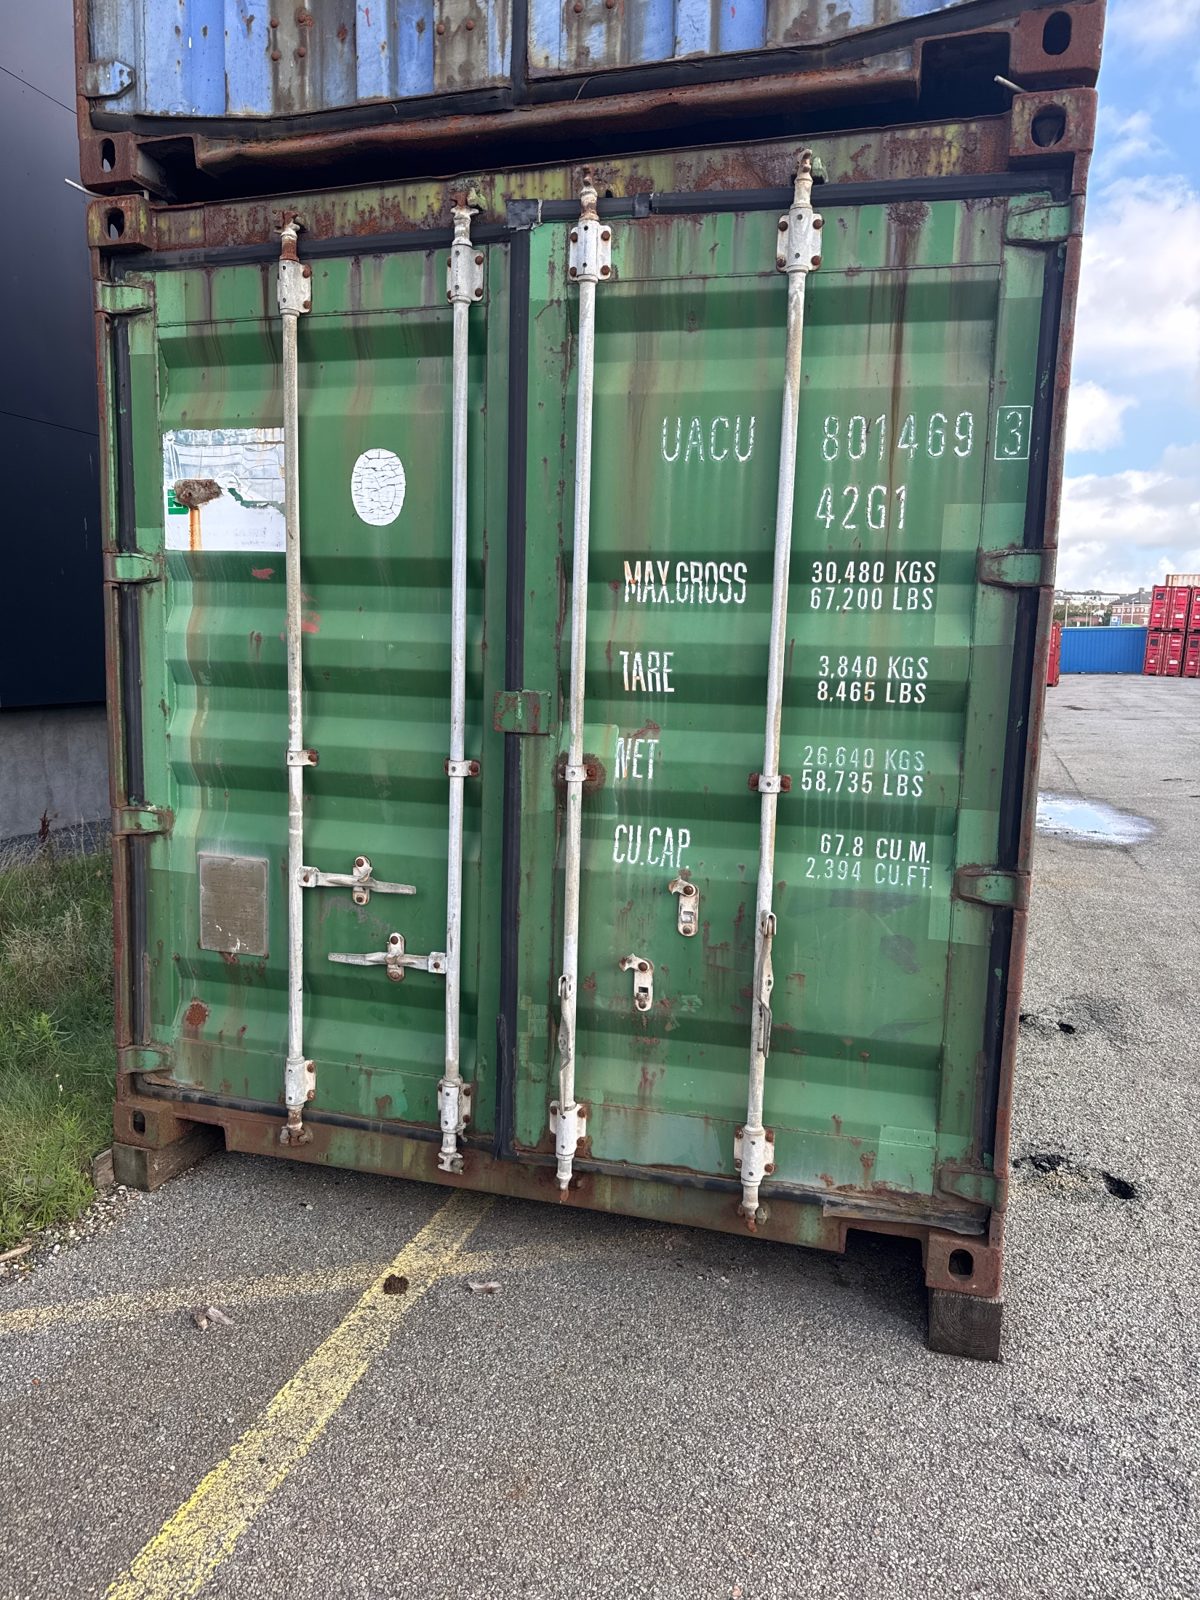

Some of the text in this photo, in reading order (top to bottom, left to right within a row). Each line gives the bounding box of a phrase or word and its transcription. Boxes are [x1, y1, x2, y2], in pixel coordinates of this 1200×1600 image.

[663, 412, 1022, 462] UACU 801469 3
[816, 485, 906, 529] 42G1
[812, 561, 884, 585] 30,480
[895, 561, 935, 583] KGS
[811, 587, 933, 610] 67,200 LBS
[620, 651, 928, 692] TARE 3,840 KGS
[817, 682, 926, 703] 8,465 LBS
[614, 738, 924, 779] NET 26,640 KGS
[802, 769, 923, 797] 58,735 LBS
[821, 834, 863, 857] 67.8
[806, 857, 862, 881] 2,394
